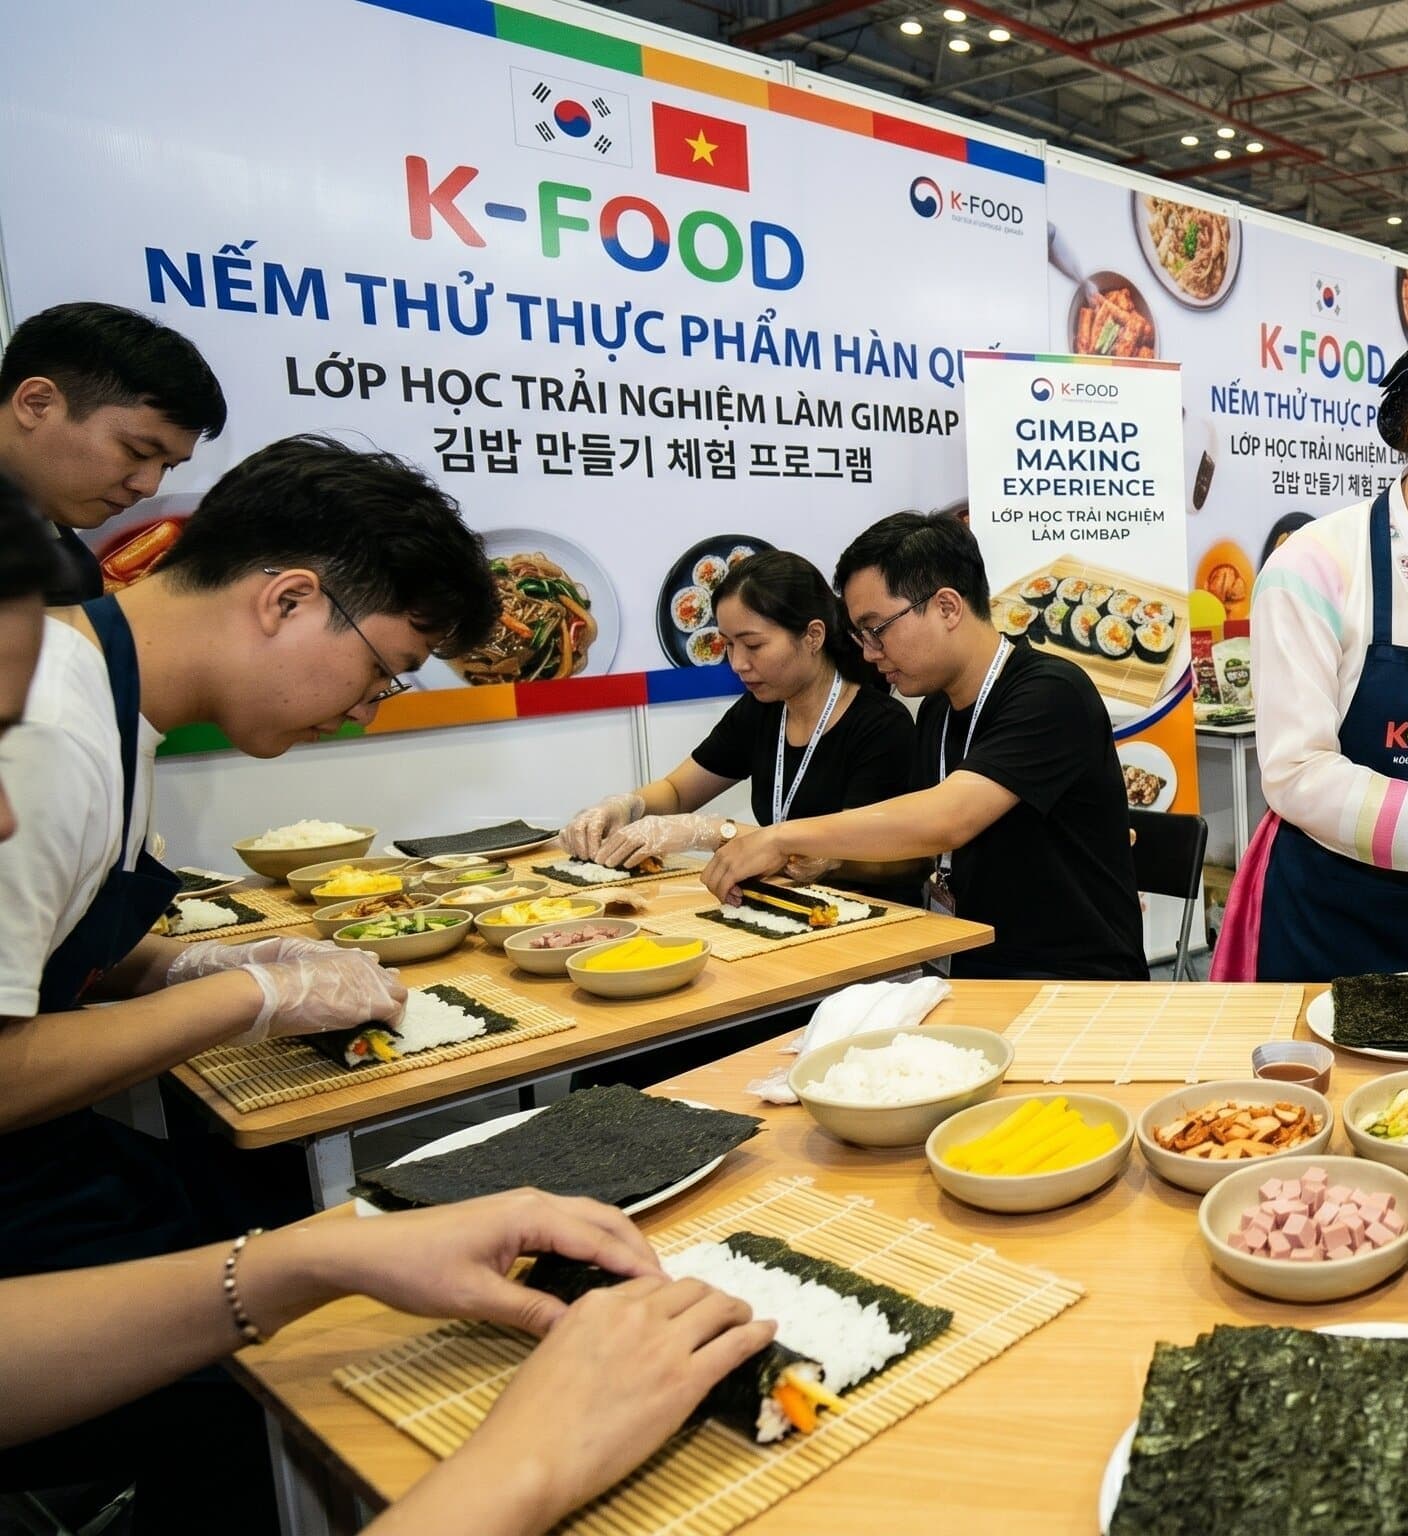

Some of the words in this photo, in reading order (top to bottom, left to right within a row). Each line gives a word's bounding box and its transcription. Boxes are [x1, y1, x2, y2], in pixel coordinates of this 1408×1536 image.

[951, 190, 1024, 224] K-FOOD
[405, 155, 805, 291] K-FOOD
[145, 240, 330, 321] NẾM
[345, 270, 494, 336] THỬ
[506, 292, 666, 364] THỰC
[681, 307, 822, 371] PHẨM
[834, 328, 918, 380] HÀN
[1260, 322, 1386, 385] K-FOOD
[286, 352, 387, 400] LỚP
[401, 365, 503, 416] HỌC
[511, 367, 608, 415] TRẢI
[619, 385, 767, 431] NGHIỆM
[775, 390, 844, 429] LÀM
[851, 402, 960, 437] GIMBAP
[1061, 382, 1119, 398] K-FOOD
[1211, 378, 1260, 417] NẾM
[1264, 387, 1308, 421] THỬ
[1310, 398, 1361, 432] THỰC
[1015, 418, 1139, 444] GIMBAP
[433, 426, 522, 475] 김밥
[536, 431, 654, 479] 만들기
[667, 437, 736, 480] 체험
[749, 443, 873, 484] 프로그램
[1016, 447, 1141, 473] MAKING
[1265, 437, 1297, 463] HỌC
[1003, 477, 1156, 497] EXPERIENCE
[1271, 470, 1301, 495] 김밥
[1304, 471, 1344, 497] 만들기
[1347, 473, 1372, 497] 체험
[992, 507, 1024, 523] LỚP
[1070, 528, 1131, 541] GIMBAP
